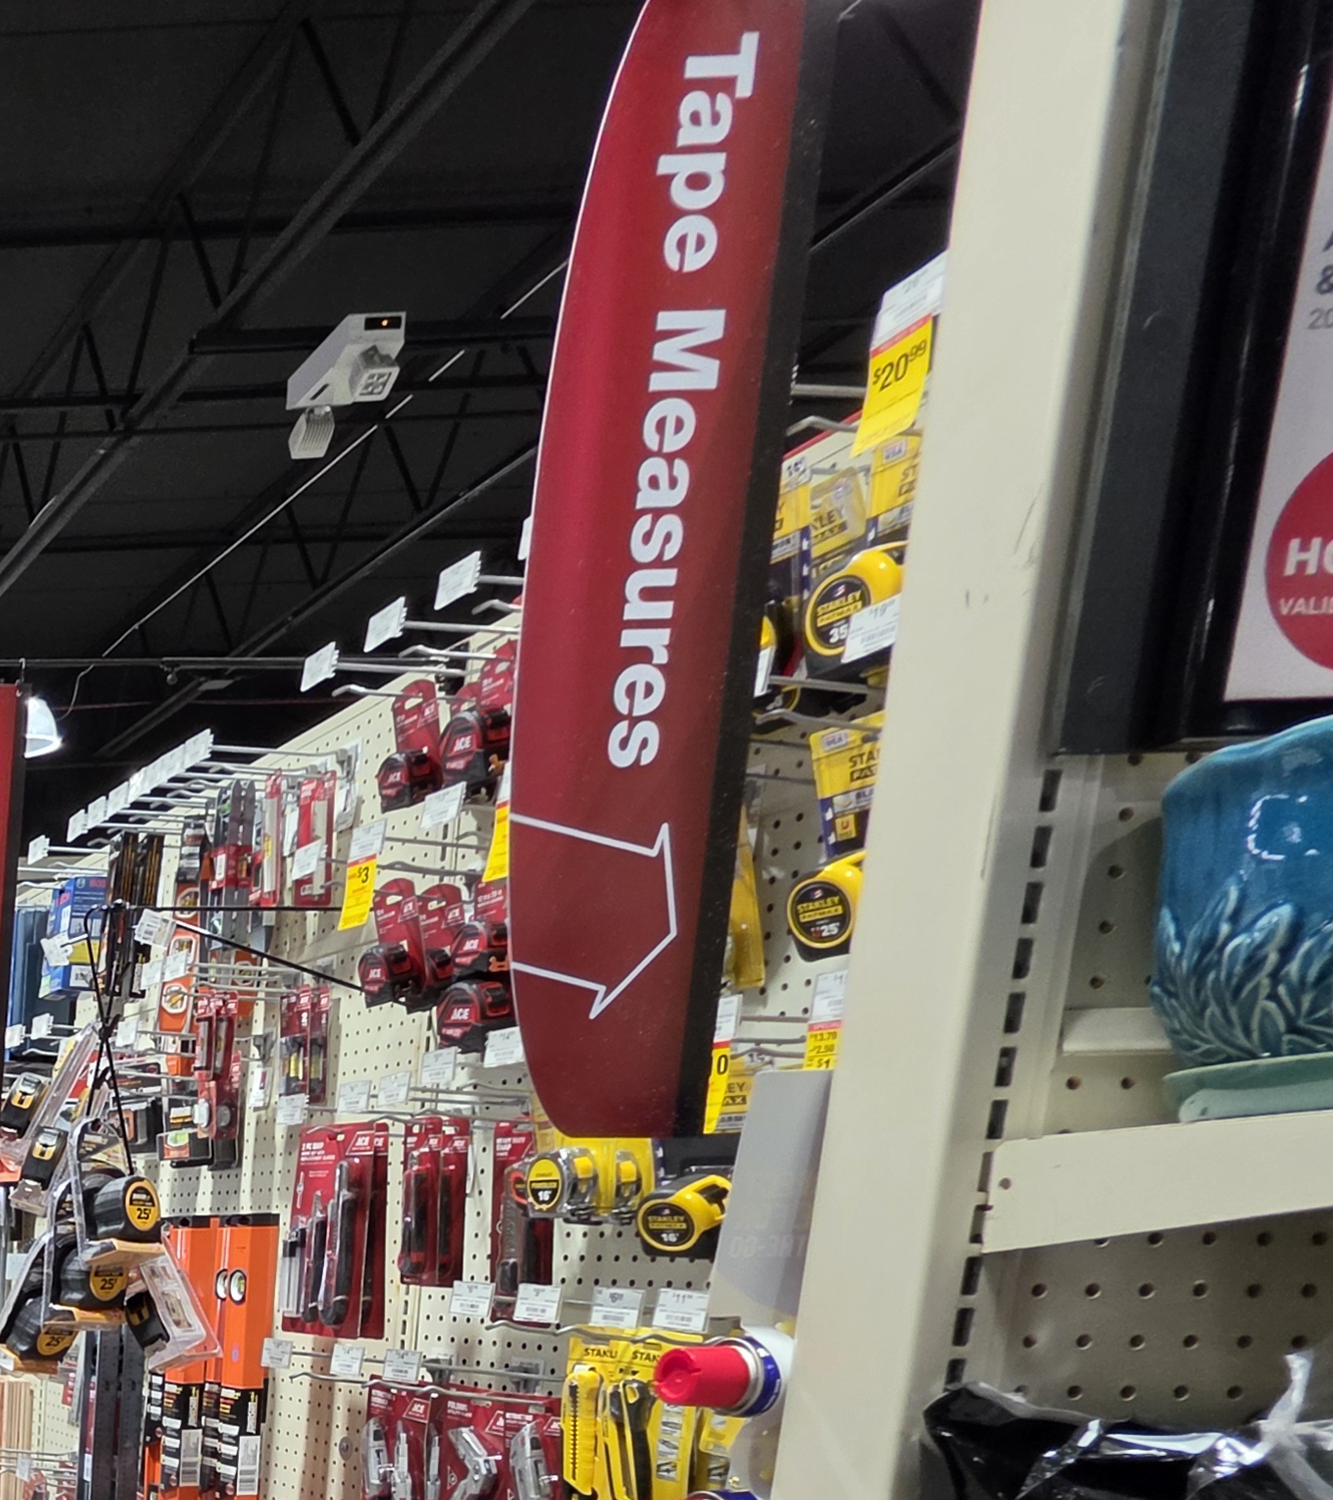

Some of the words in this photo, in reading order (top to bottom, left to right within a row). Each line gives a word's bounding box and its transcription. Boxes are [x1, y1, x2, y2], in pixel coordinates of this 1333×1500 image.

[656, 30, 759, 274] Tape
[607, 308, 727, 769] Measures
[454, 735, 472, 752] ACE
[451, 1008, 470, 1020] ACE
